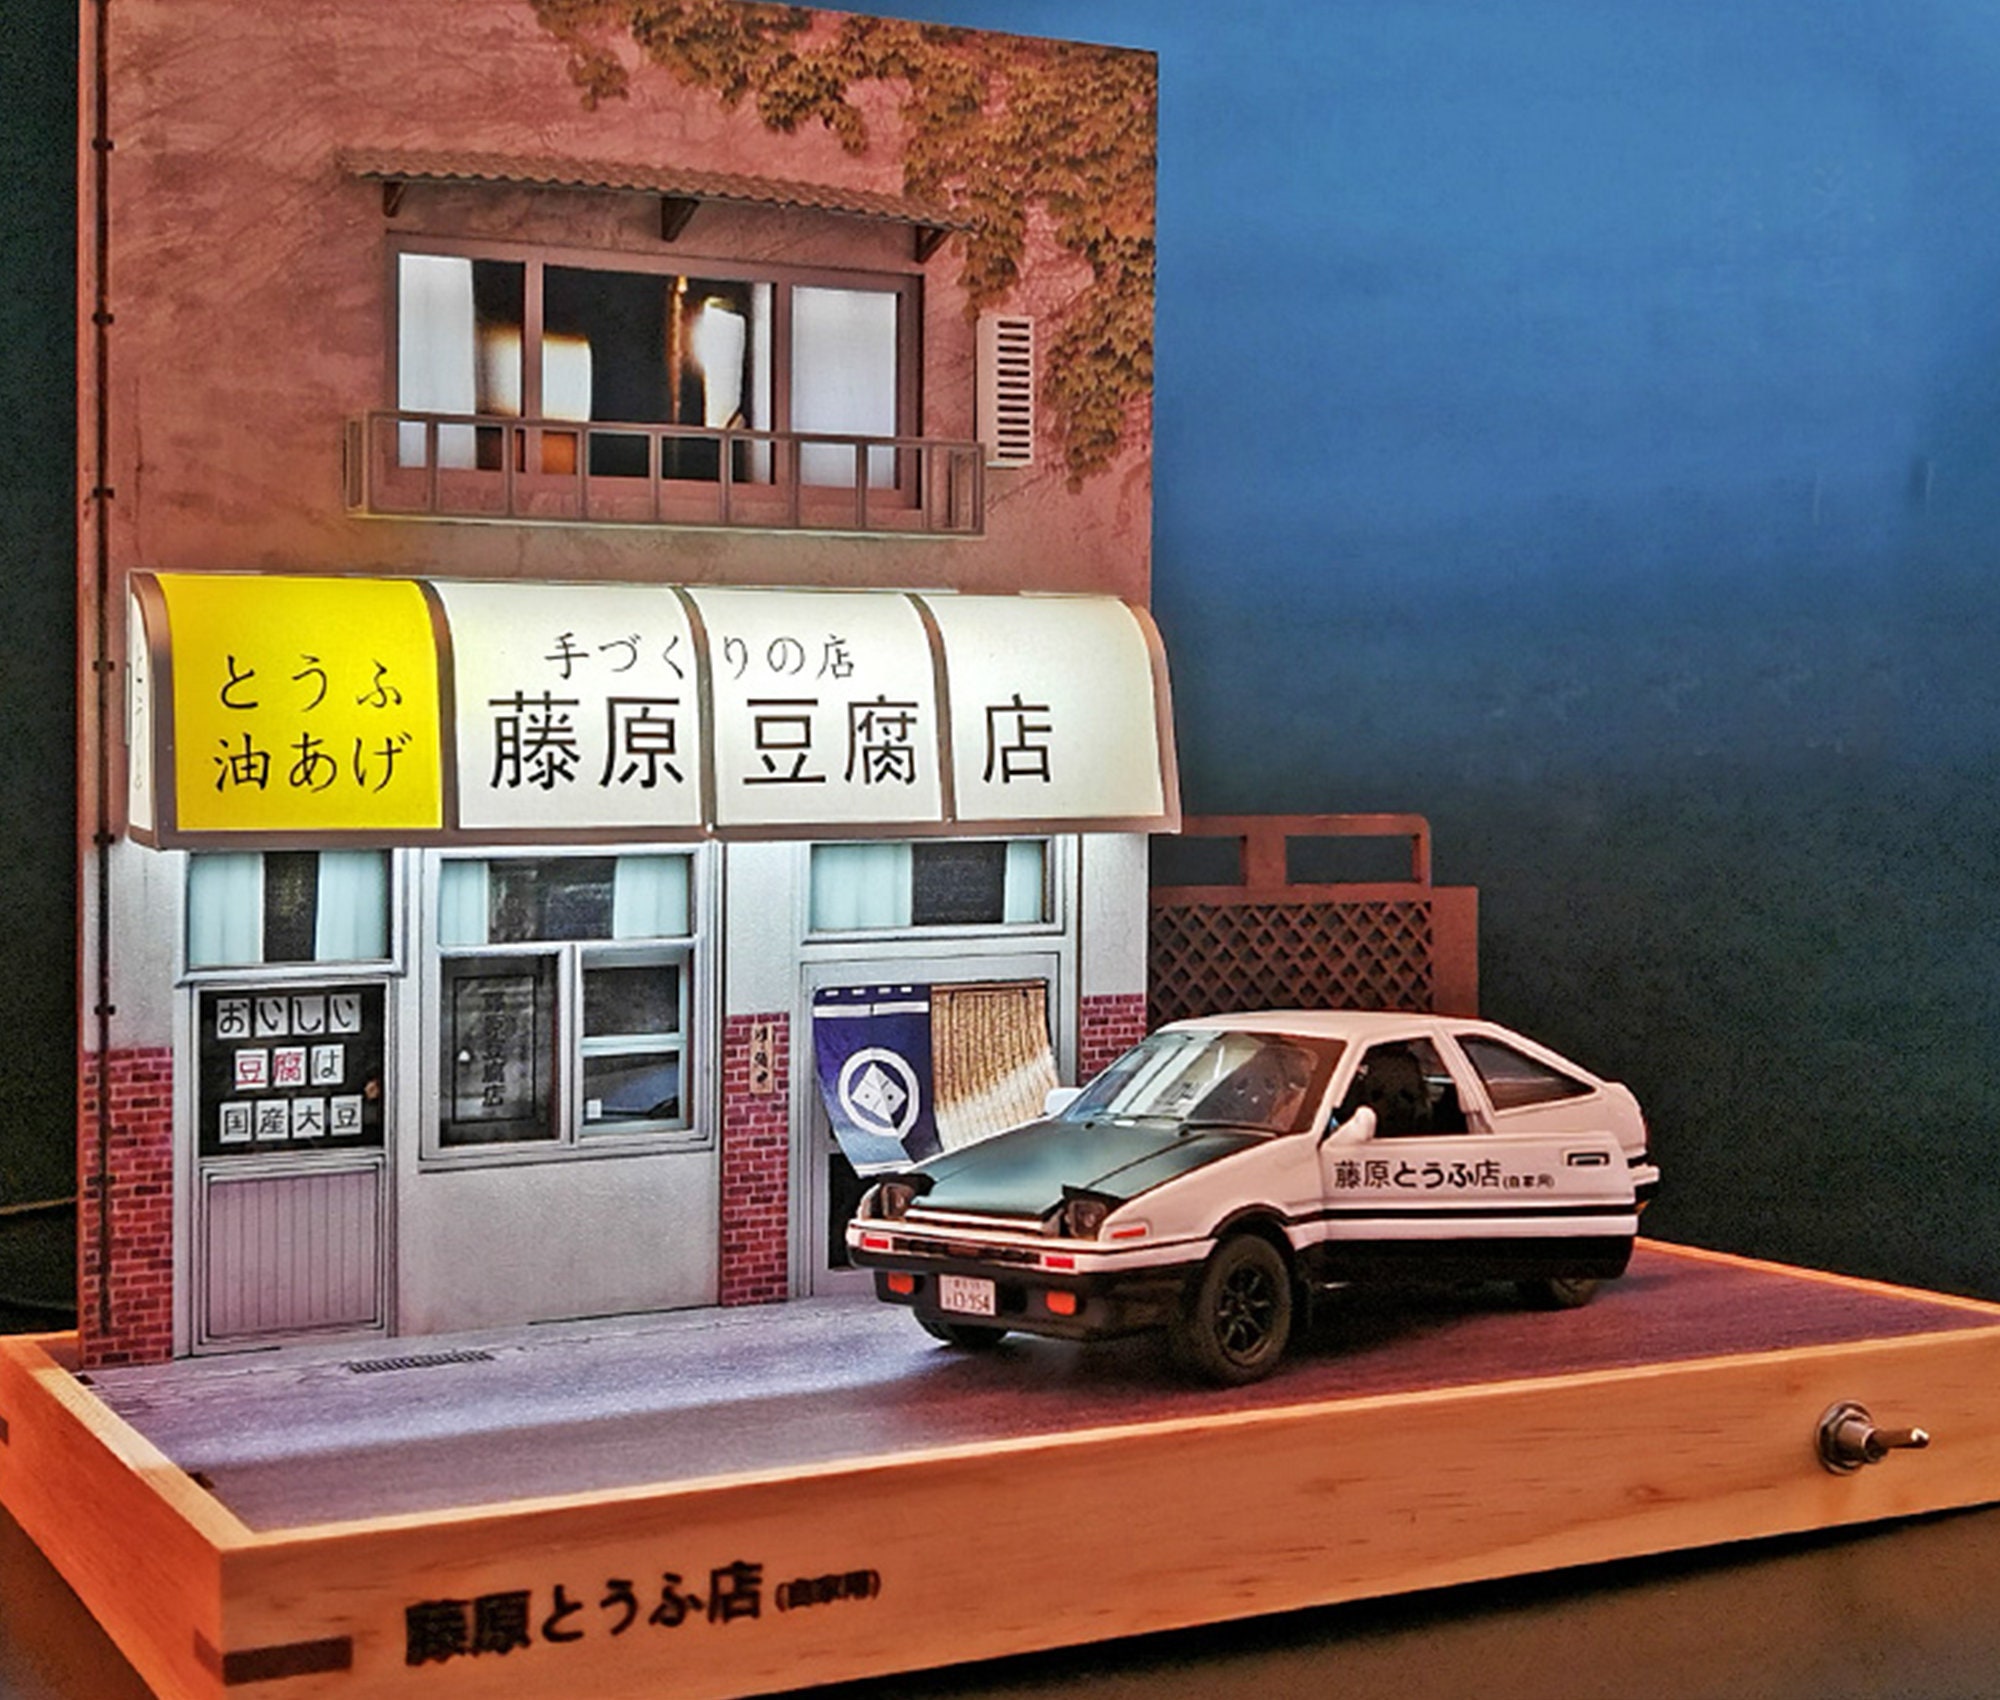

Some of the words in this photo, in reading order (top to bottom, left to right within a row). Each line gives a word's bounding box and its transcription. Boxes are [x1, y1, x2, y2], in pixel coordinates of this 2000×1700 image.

[544, 632, 855, 681] 手づくりの店
[218, 654, 403, 712] とうふ
[489, 690, 1054, 789] 藤原豆腐店
[212, 731, 413, 794] 油あげ
[219, 998, 353, 1033] おいしい
[235, 1050, 340, 1085] 豆腐は
[224, 1102, 359, 1135] 国産大豆
[1334, 1160, 1500, 1189] 藤原とうふ店
